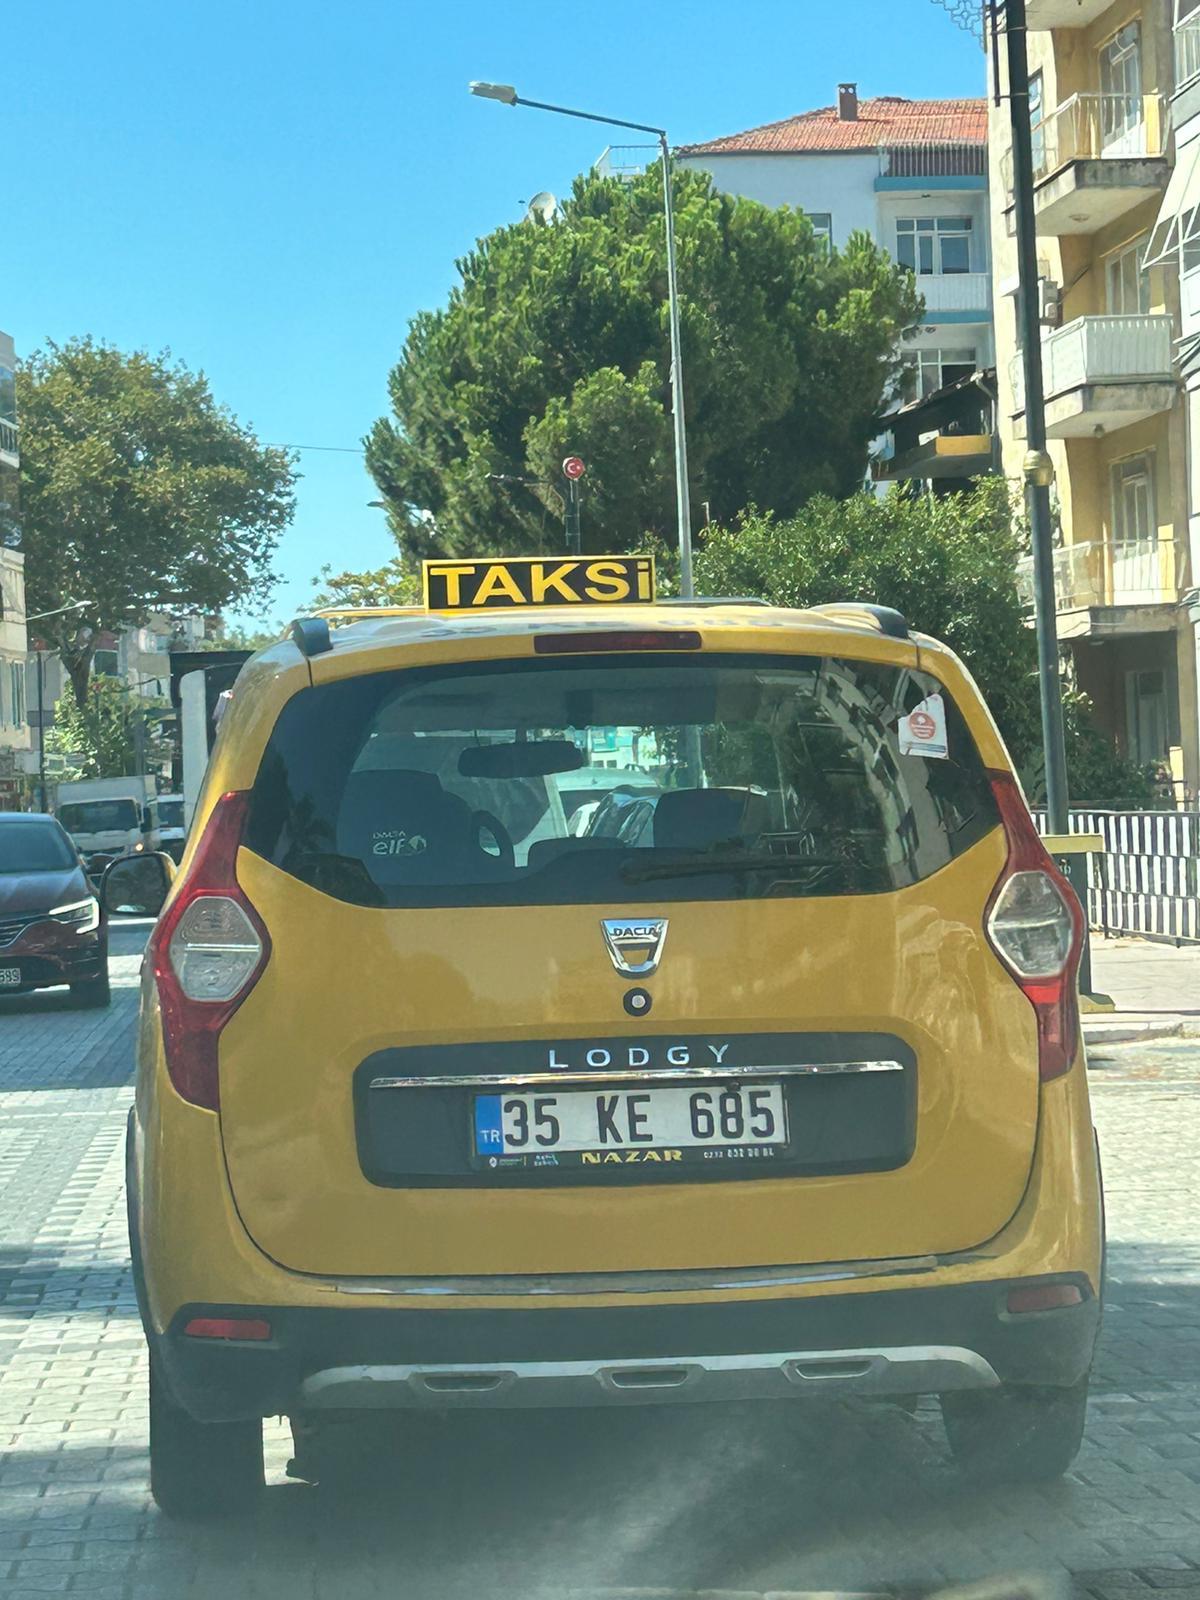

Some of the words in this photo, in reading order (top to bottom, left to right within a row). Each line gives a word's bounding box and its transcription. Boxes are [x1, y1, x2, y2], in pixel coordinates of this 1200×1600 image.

[373, 838, 405, 855] elf
[613, 926, 659, 937] DACIA
[549, 1044, 729, 1068] LODGY
[503, 1098, 560, 1147] 35
[596, 1094, 654, 1144] KE
[689, 1090, 776, 1140] 685
[480, 1130, 500, 1143] TR
[581, 1149, 682, 1164] NAZAR
